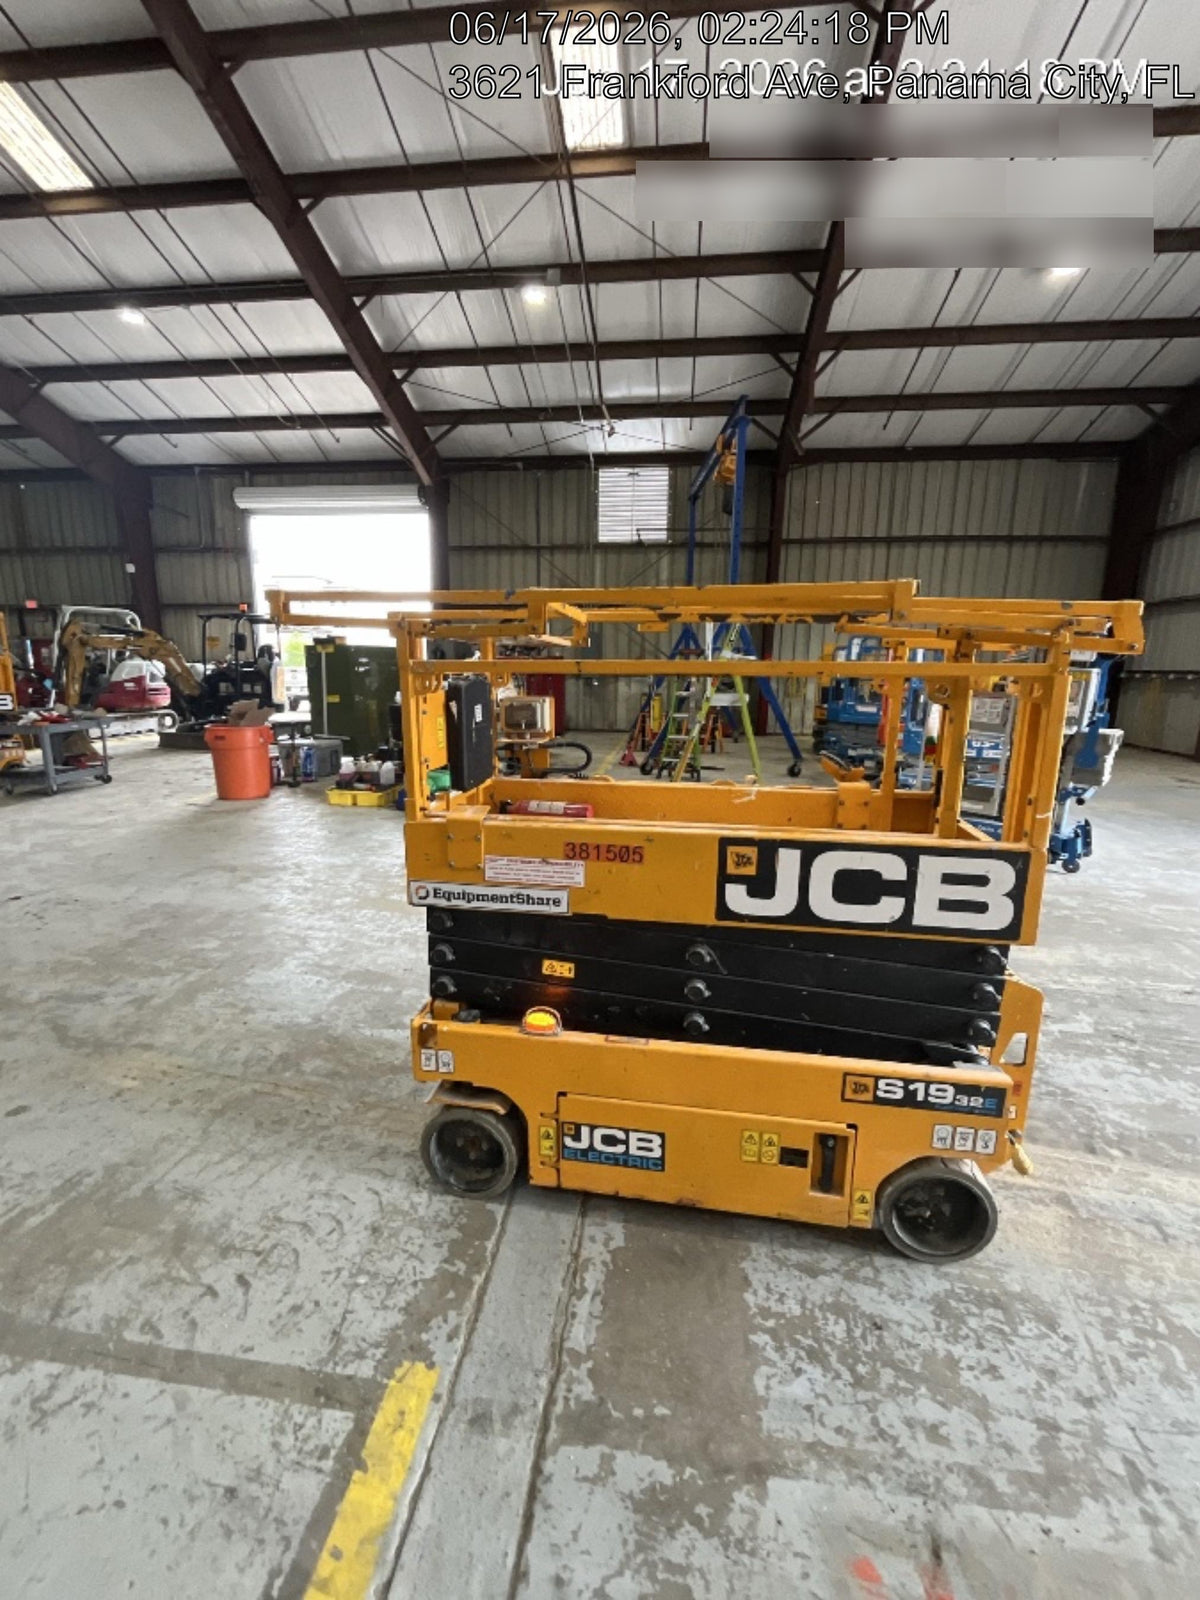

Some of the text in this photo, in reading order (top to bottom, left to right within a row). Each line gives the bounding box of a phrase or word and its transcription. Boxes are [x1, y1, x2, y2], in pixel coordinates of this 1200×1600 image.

[565, 842, 645, 863] 381505
[432, 887, 562, 908] EquipmentShare
[725, 847, 1018, 932] JCB
[563, 1125, 662, 1158] JCB
[563, 1148, 663, 1170] ELECTRIC
